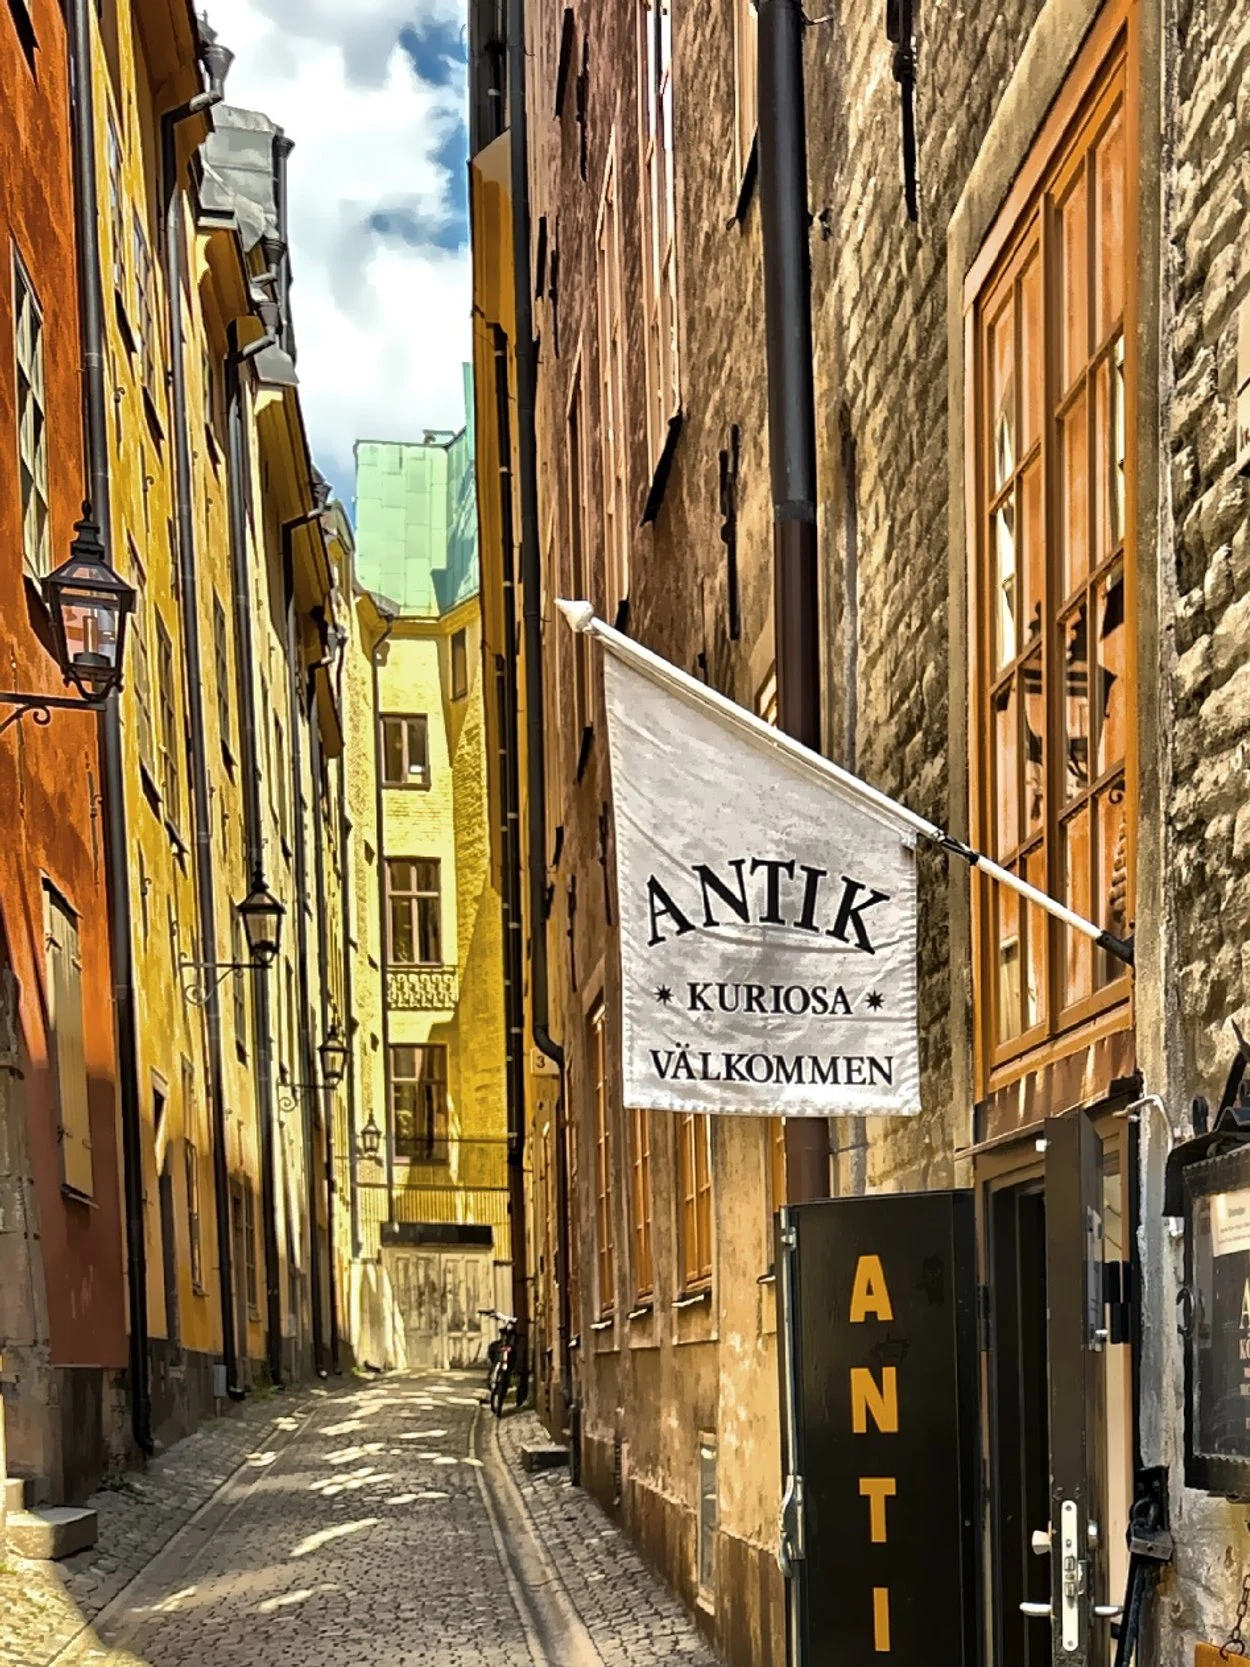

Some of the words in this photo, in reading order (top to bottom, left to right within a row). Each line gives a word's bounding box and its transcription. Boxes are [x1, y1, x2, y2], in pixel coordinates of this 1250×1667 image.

[646, 857, 891, 955] ANTIK
[686, 982, 854, 1015] KURIOSA
[649, 1042, 894, 1085] VÄLKOMMEN
